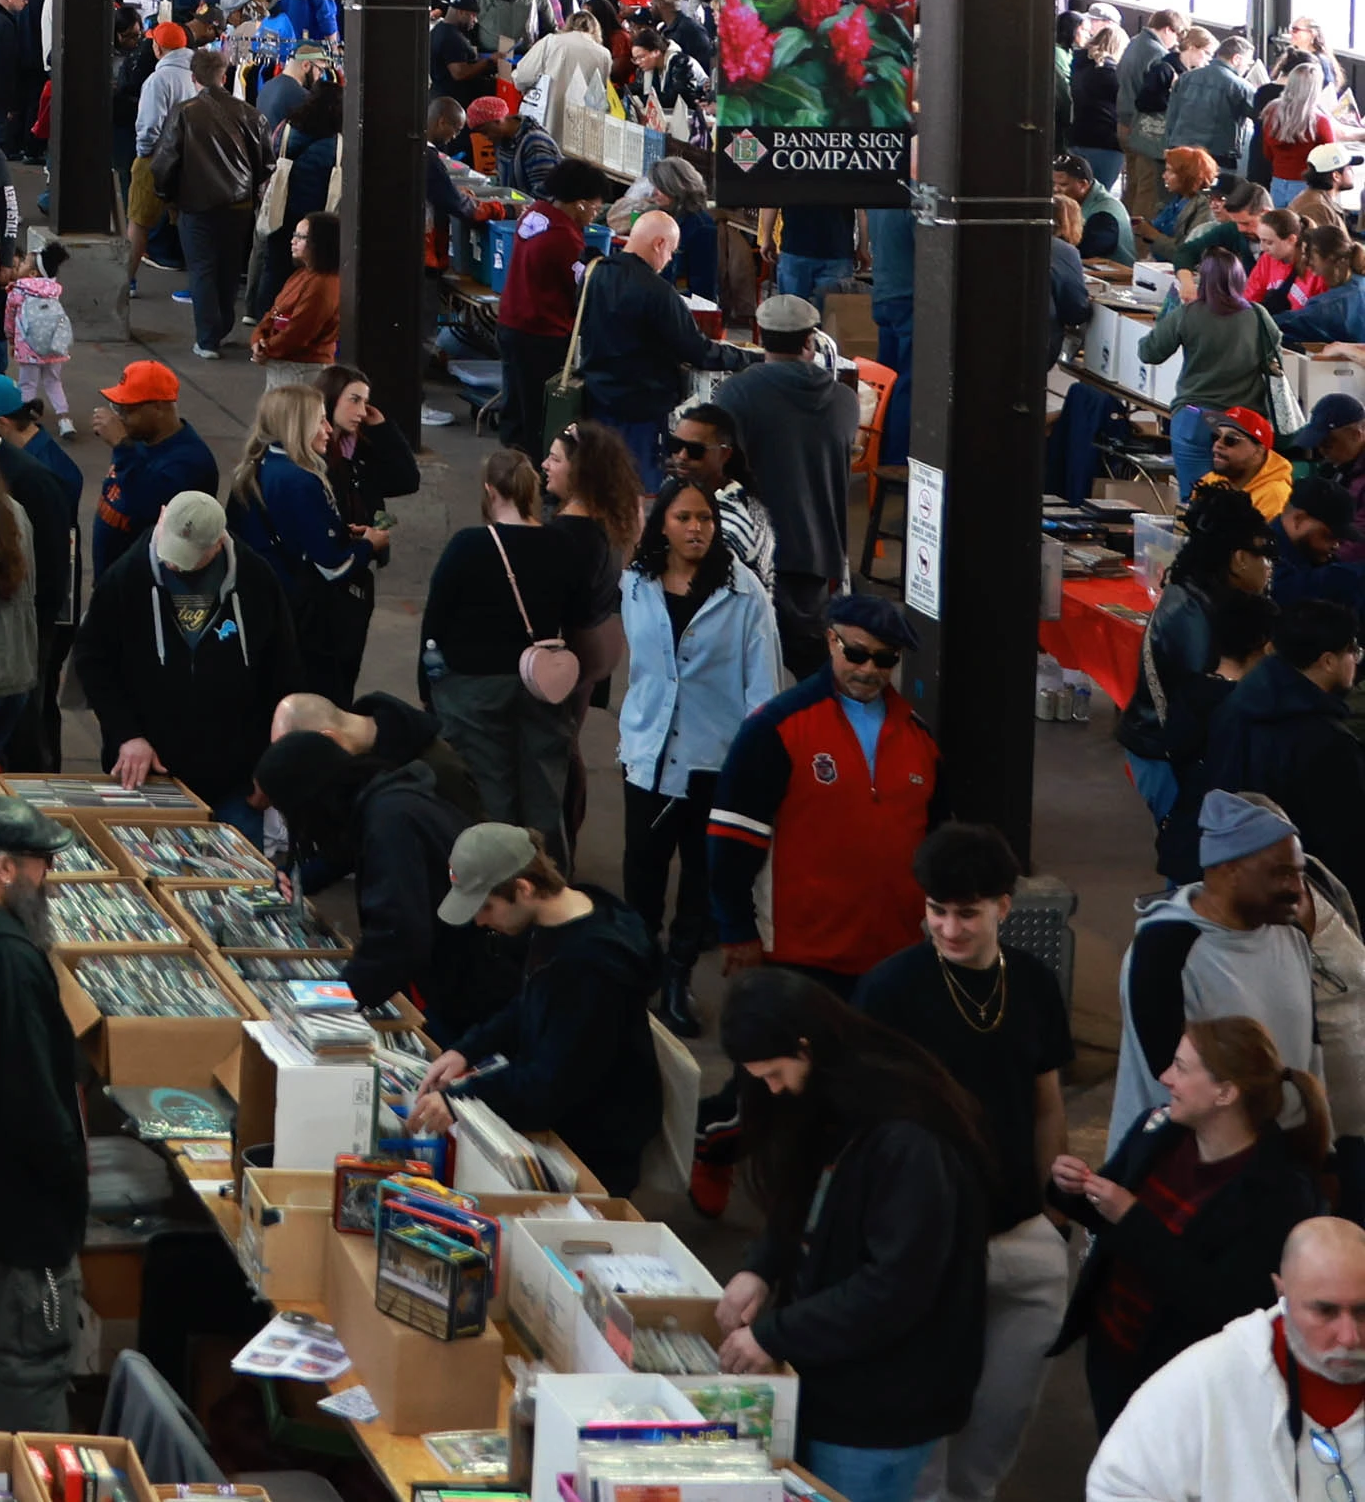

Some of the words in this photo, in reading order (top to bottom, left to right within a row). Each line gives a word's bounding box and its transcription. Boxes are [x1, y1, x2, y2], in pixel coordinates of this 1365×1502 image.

[773, 132, 854, 148] BANNER
[858, 132, 905, 149] SIGN
[772, 149, 902, 171] COMPANY
